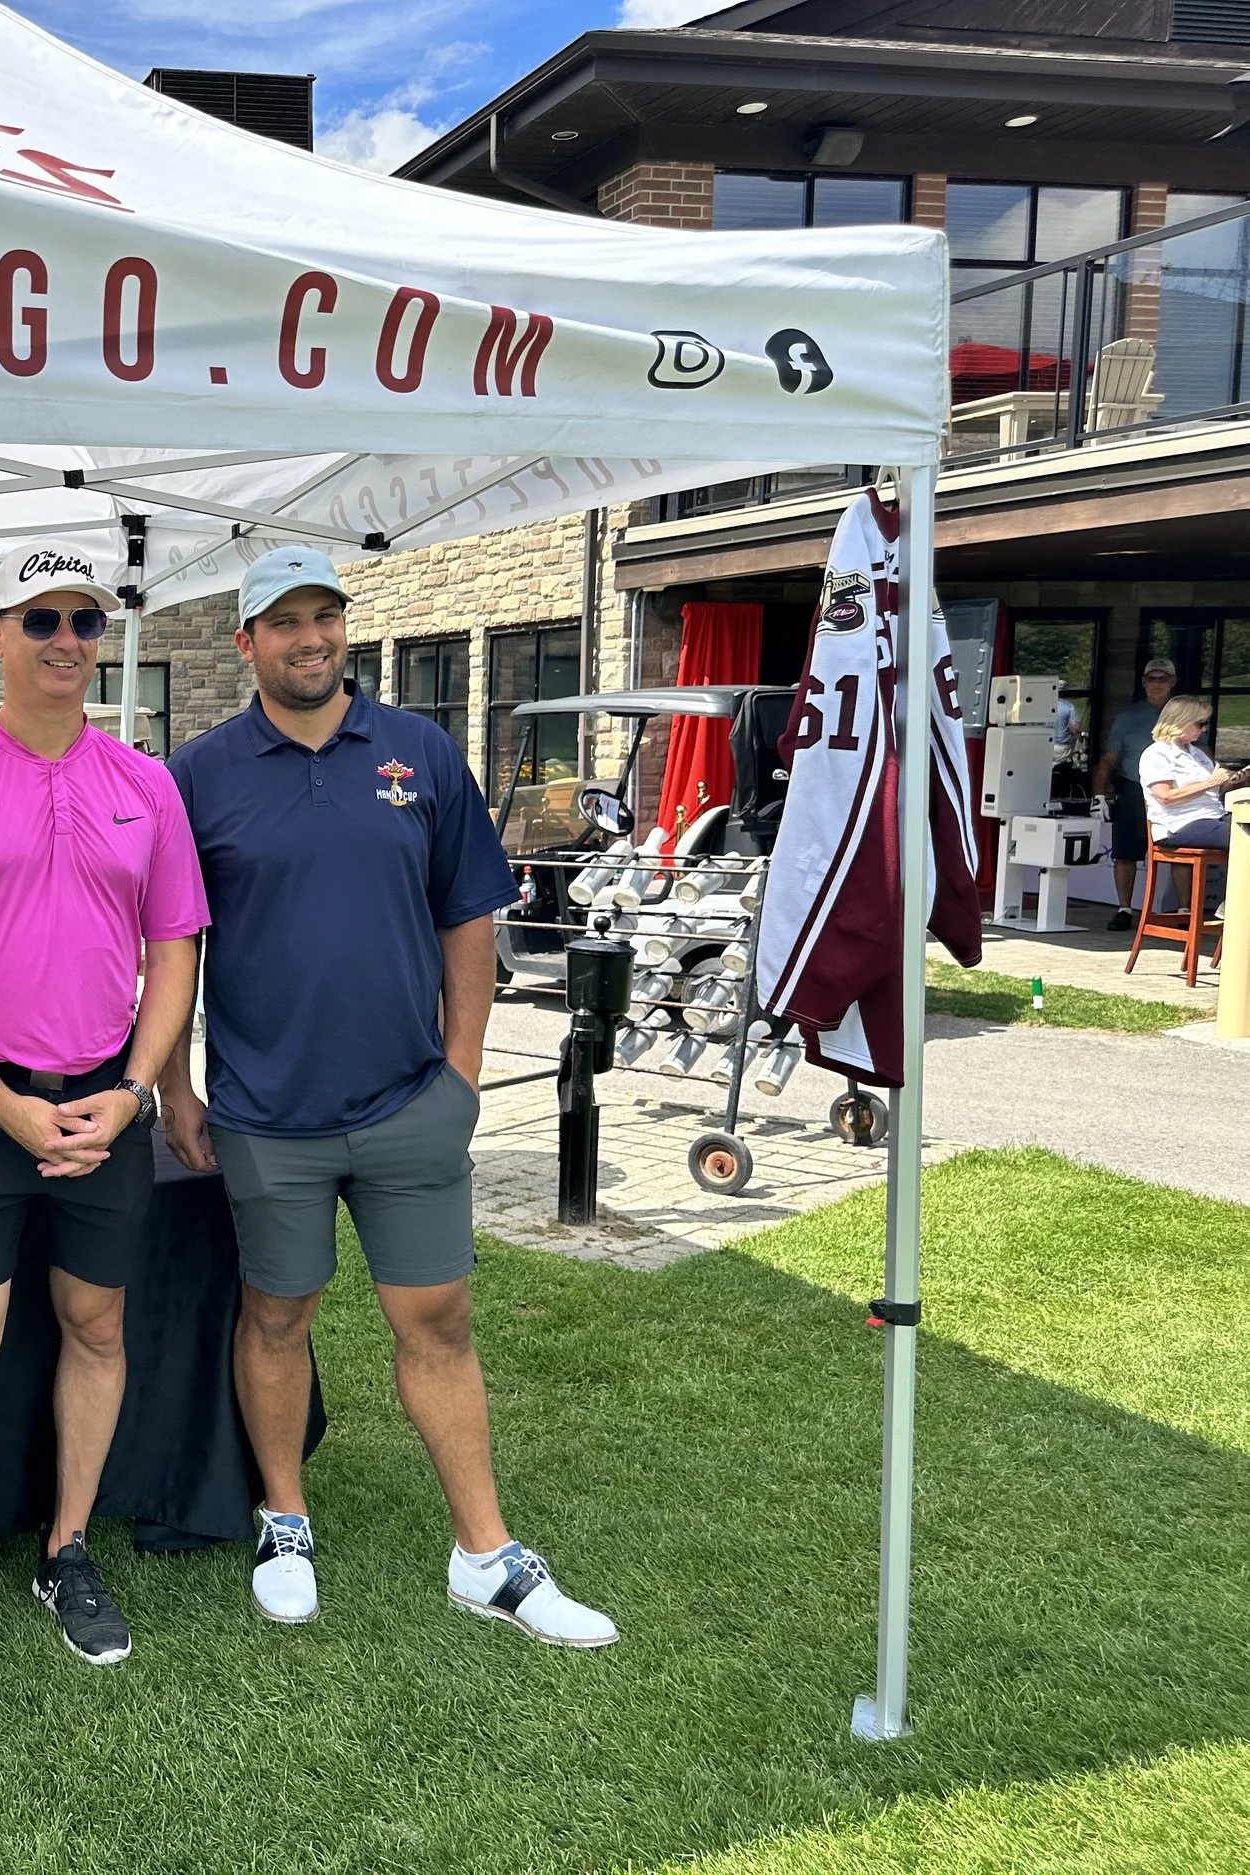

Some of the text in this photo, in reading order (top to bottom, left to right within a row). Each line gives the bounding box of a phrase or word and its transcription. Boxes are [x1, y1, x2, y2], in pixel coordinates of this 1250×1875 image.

[40, 550, 57, 559] The
[19, 554, 95, 583] Capital
[795, 674, 859, 751] 61
[403, 791, 418, 802] CUP
